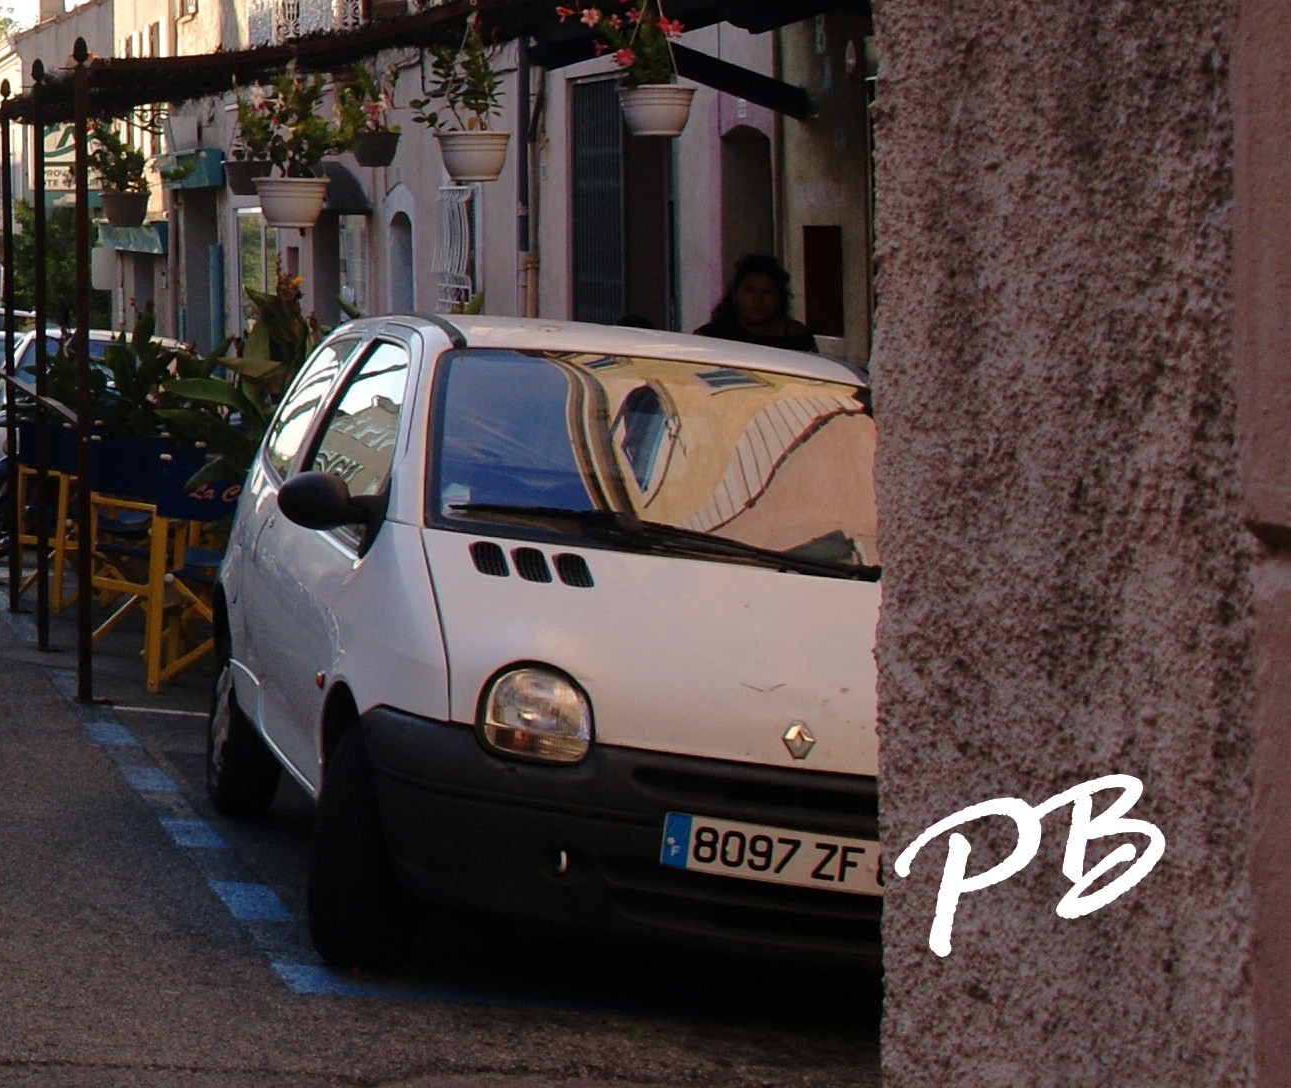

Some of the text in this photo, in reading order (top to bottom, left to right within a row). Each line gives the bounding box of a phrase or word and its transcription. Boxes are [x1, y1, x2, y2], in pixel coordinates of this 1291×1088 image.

[670, 845, 681, 857] F
[693, 826, 801, 874] 8097
[810, 842, 866, 882] ZF
